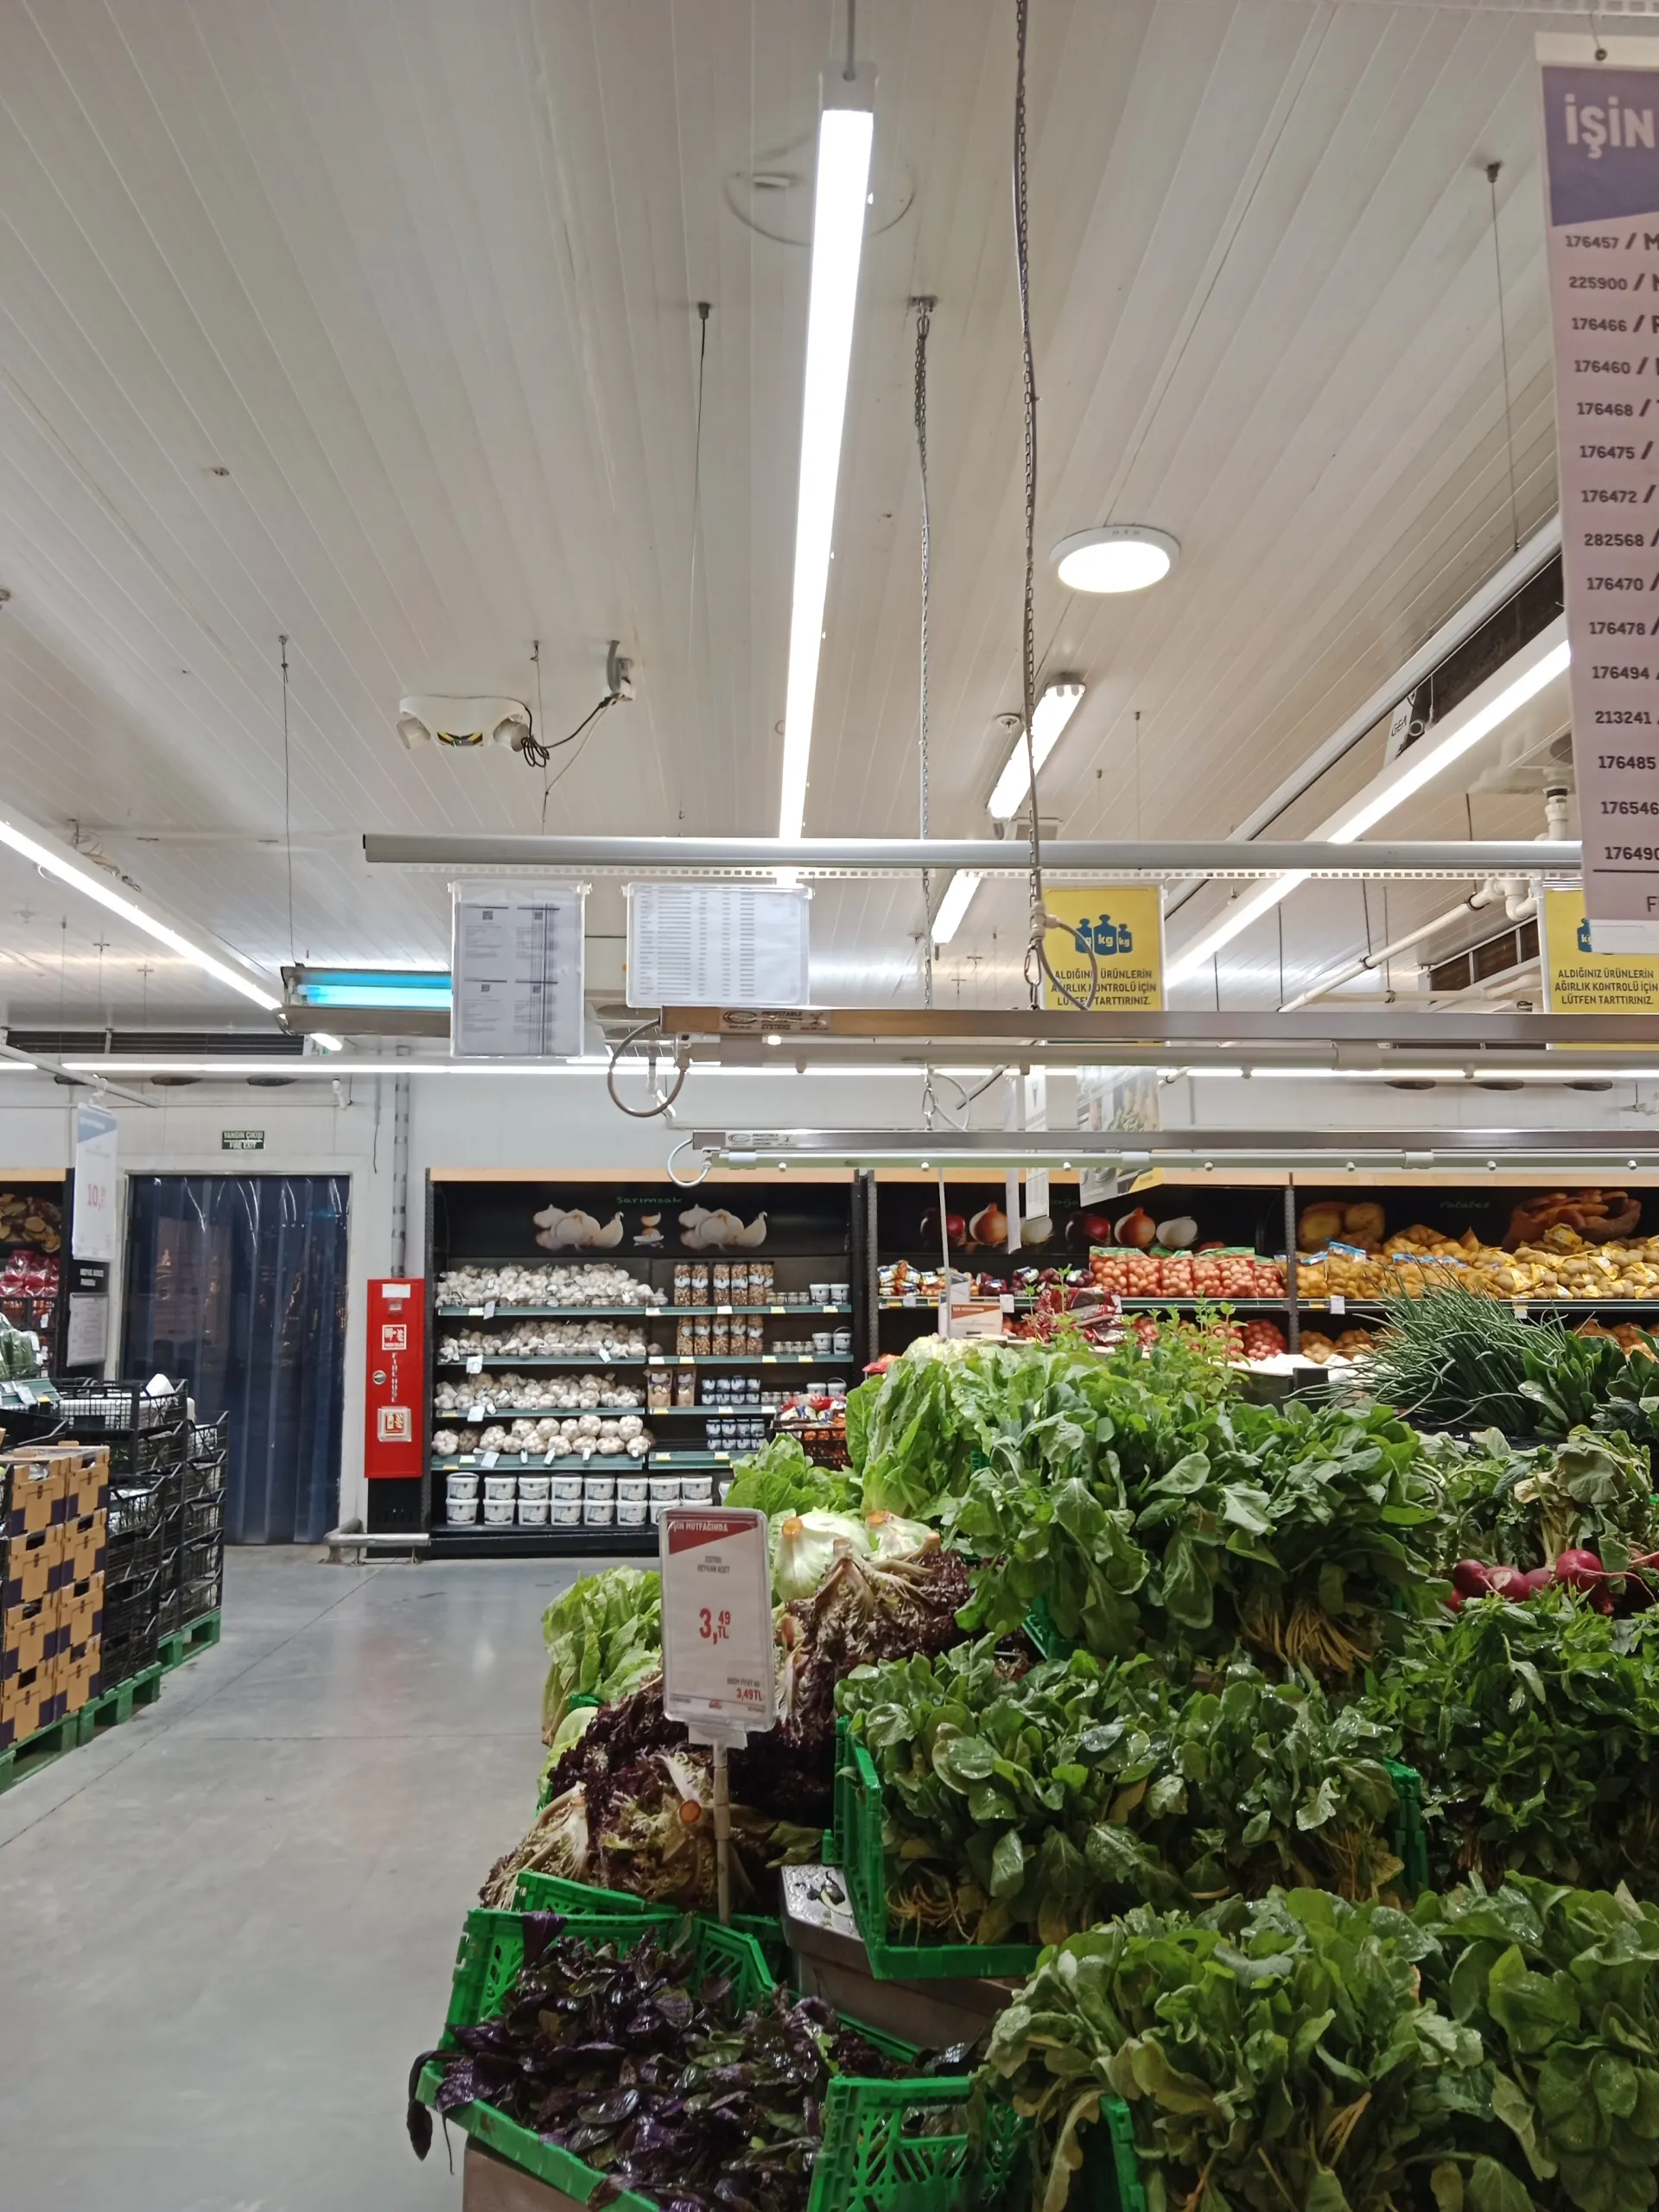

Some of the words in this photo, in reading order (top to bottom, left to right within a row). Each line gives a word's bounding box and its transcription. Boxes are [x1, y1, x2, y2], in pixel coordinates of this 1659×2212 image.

[1565, 93, 1656, 159] İŞİN
[1566, 235, 1619, 249] 176457
[1569, 276, 1628, 290] 225900
[1572, 317, 1627, 332] 176466
[1574, 359, 1631, 374] 176460
[1577, 402, 1634, 416] 176468
[1580, 445, 1636, 460] 176475
[1581, 490, 1637, 504] 176472
[1584, 533, 1645, 547] 282568
[1586, 577, 1644, 591] 176470
[1589, 621, 1646, 636] 176478
[1592, 666, 1649, 680] 176494
[1595, 711, 1651, 725] 213241
[1599, 756, 1656, 770] 176485
[1601, 801, 1659, 815] 176546
[1098, 934, 1114, 947] kg
[1119, 937, 1130, 947] kg
[1100, 968, 1152, 979] ÜRÜNLERİN
[1558, 967, 1602, 978] ALDIĞINIZ
[1604, 968, 1654, 978] ÜRÜNLERİN
[1138, 982, 1156, 995] İÇİN
[1555, 980, 1591, 991] AĞIRLIK
[1592, 981, 1638, 992] KONTROLÜ
[1640, 981, 1658, 994] İÇİN
[1561, 994, 1596, 1004] LÜTFEN
